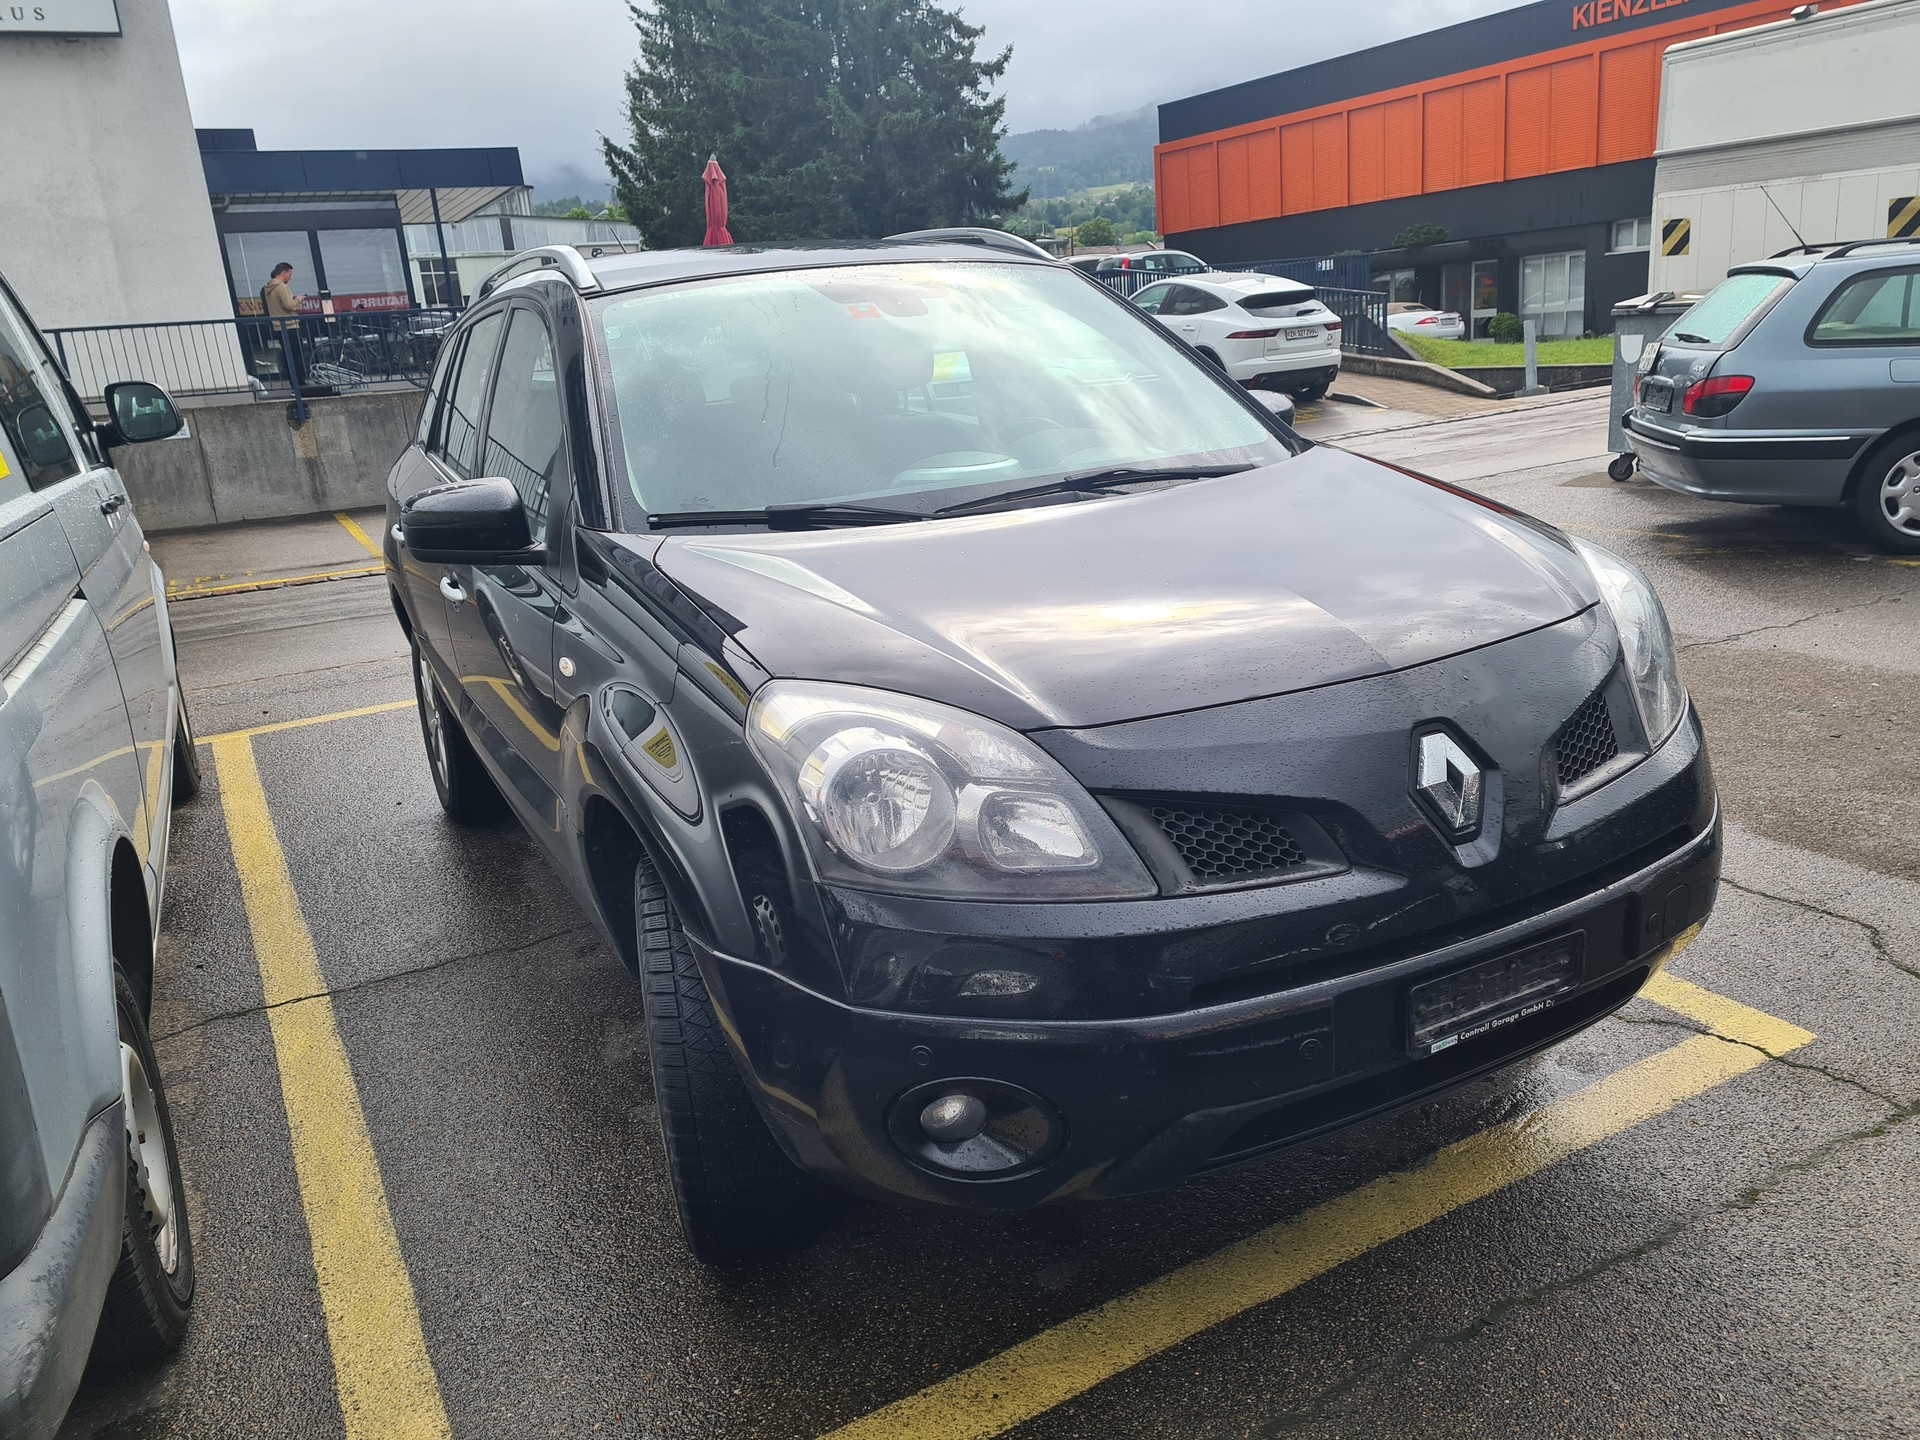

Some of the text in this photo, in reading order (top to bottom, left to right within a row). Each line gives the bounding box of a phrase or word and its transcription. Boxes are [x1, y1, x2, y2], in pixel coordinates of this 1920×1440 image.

[1572, 0, 1690, 31] KIENZL
[1460, 1022, 1490, 1040] Controll
[1491, 1012, 1519, 1028] Garage
[1521, 1002, 1544, 1016] GmbH
